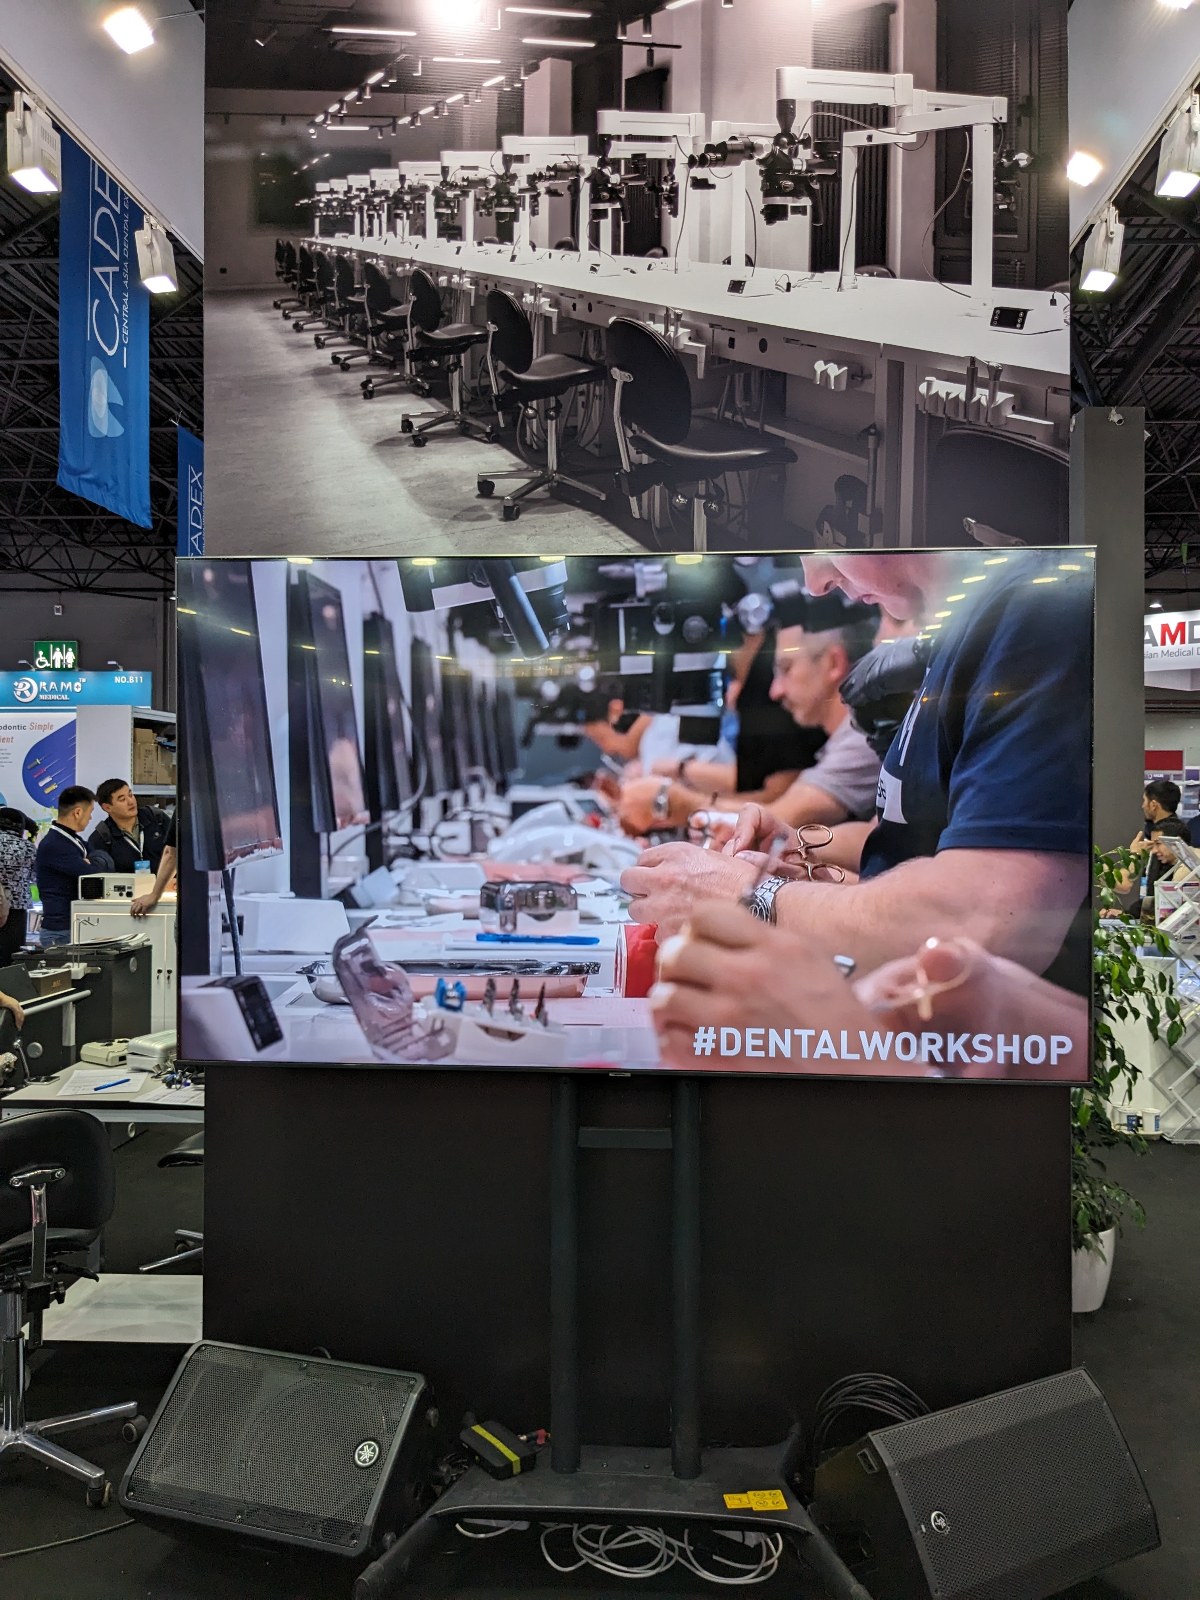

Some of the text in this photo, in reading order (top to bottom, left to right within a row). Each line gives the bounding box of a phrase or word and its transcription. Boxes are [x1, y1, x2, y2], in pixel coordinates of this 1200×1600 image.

[190, 465, 203, 556] ADEX
[1161, 647, 1194, 658] Medical
[114, 676, 143, 684] NO.B11
[29, 722, 54, 732] Simple
[693, 1026, 1073, 1066] #DENTALWORKSHOP
